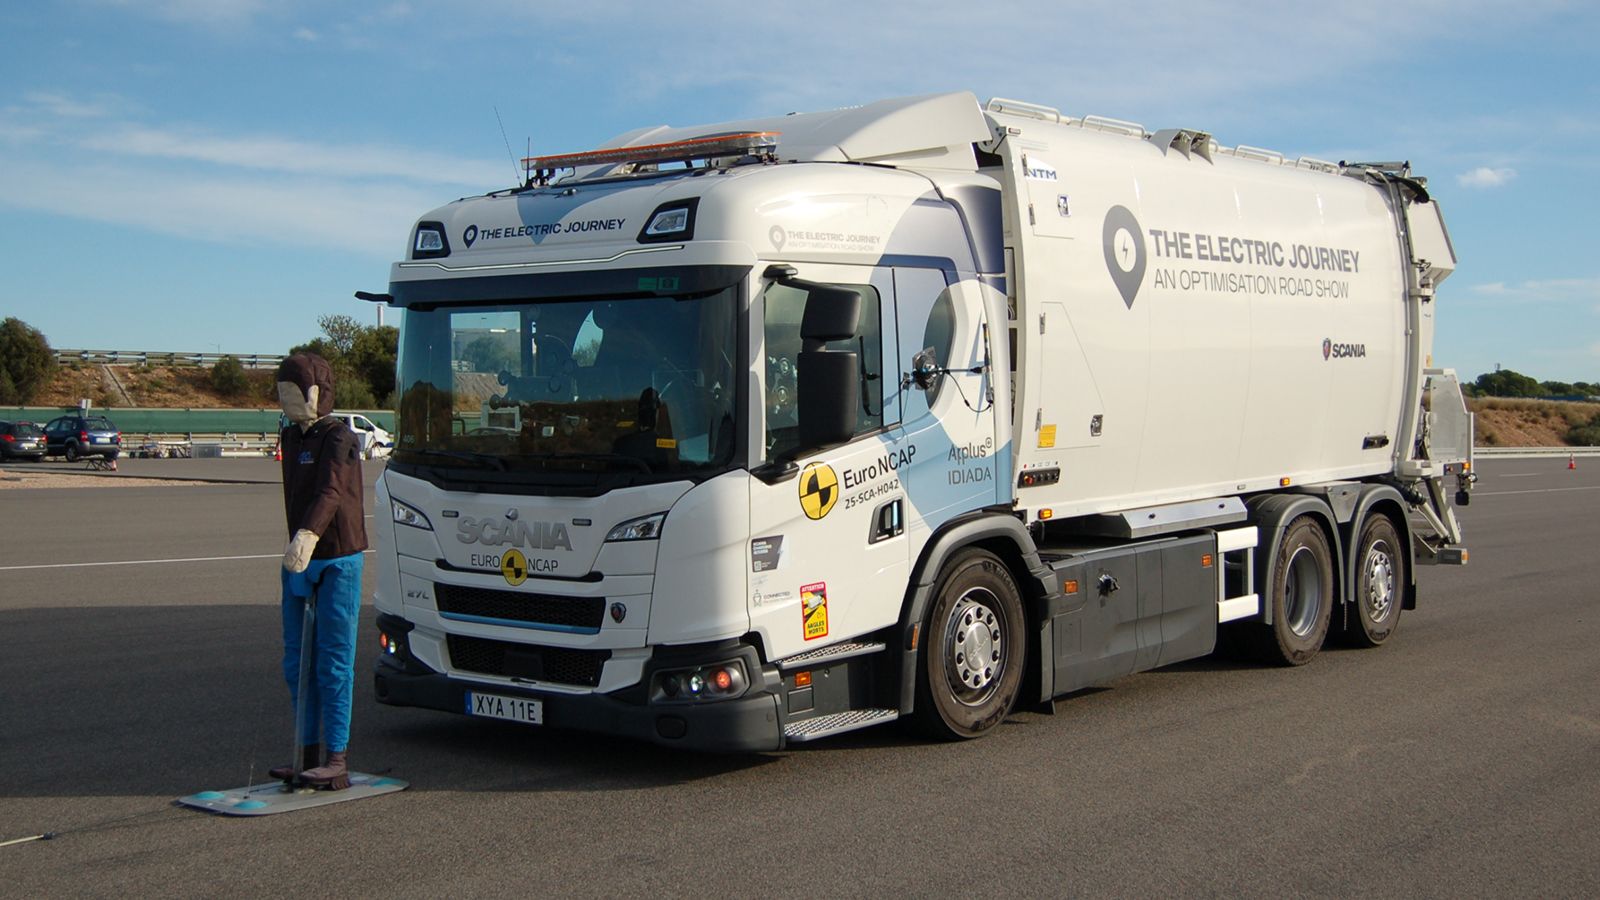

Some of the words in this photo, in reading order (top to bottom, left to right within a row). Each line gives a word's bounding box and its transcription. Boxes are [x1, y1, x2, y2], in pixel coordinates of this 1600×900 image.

[1027, 168, 1057, 180] NTM
[480, 228, 502, 241] THE
[504, 222, 562, 239] ELECTRIC
[564, 218, 626, 233] JOURNEY
[787, 231, 804, 240] THE
[806, 232, 844, 241] ELECTRIC
[846, 234, 881, 244] JOURNEY
[1149, 229, 1193, 260] THE
[1196, 233, 1285, 268] ELECTRIC
[1288, 243, 1360, 273] JOURNEY
[1154, 268, 1177, 290] AN
[1180, 270, 1276, 295] OPTIMISATION
[1279, 276, 1313, 297] ROAD
[1316, 280, 1349, 299] SHOW
[1332, 343, 1366, 359] SCANIA
[843, 467, 877, 490] Euro
[878, 444, 917, 476] NCAP
[948, 466, 992, 485] IDIADA
[844, 482, 900, 510] 25-SCA-H042
[455, 515, 574, 552] SCANIA
[471, 553, 501, 569] EURO
[528, 558, 559, 573] NCAP
[475, 694, 506, 719] XYA
[509, 699, 536, 722] 11E
